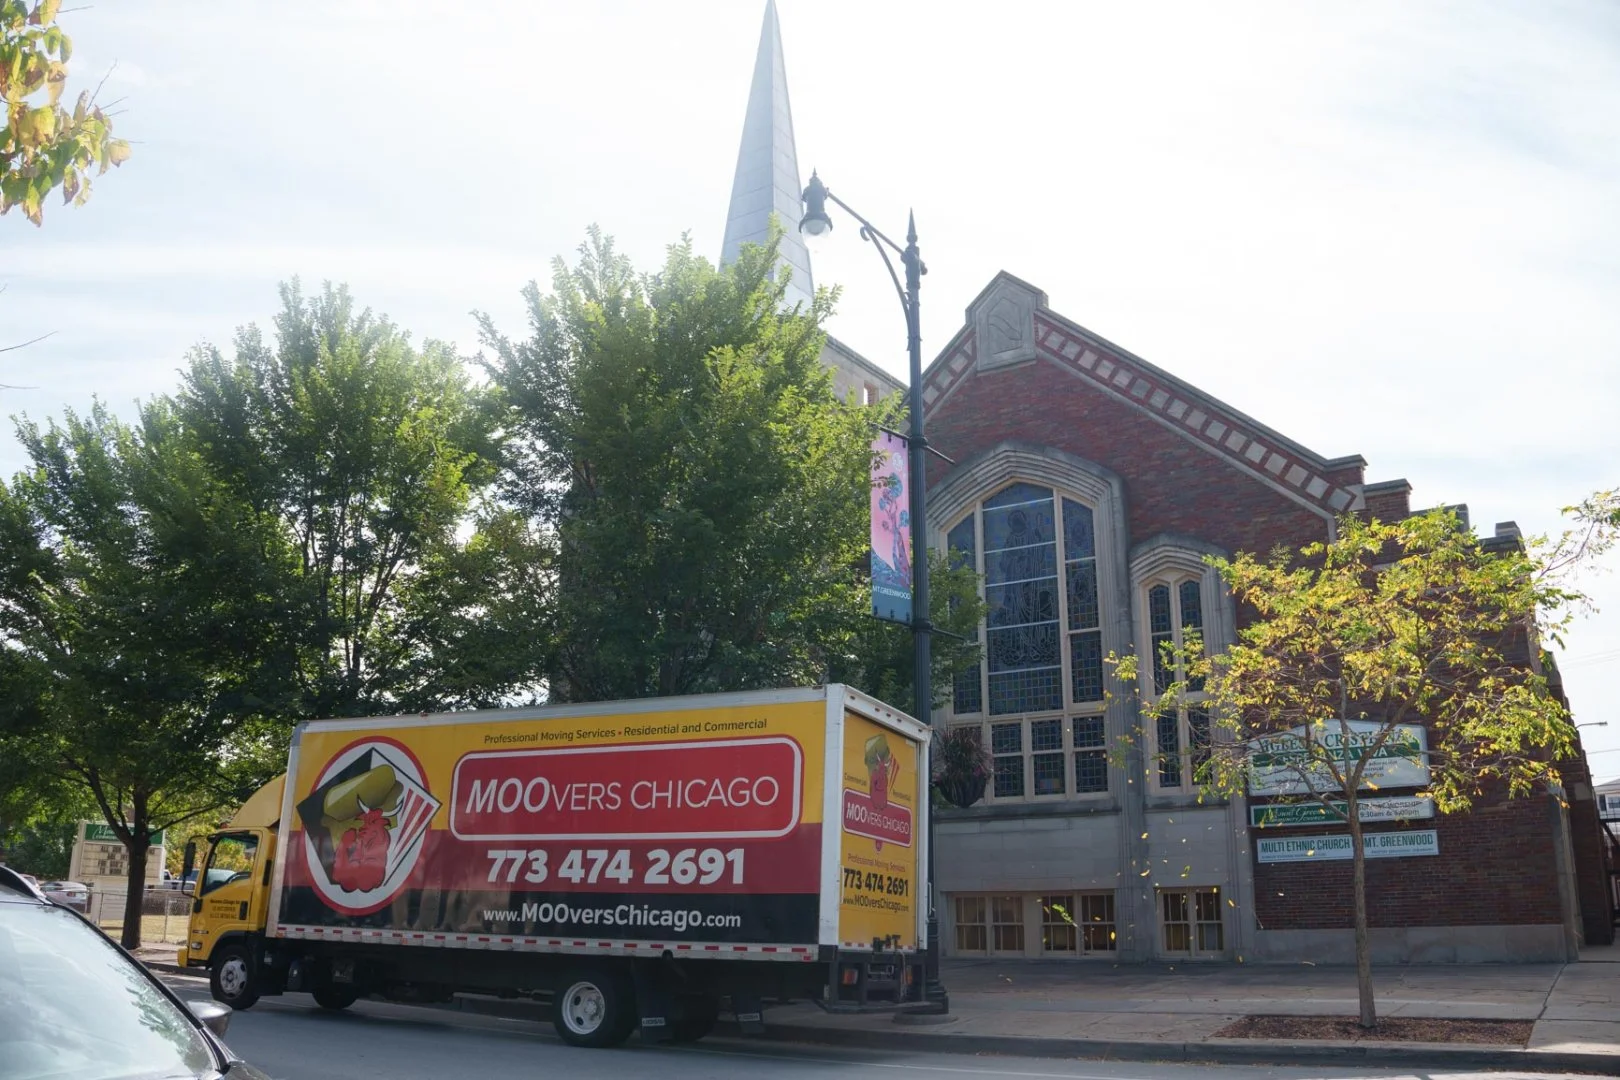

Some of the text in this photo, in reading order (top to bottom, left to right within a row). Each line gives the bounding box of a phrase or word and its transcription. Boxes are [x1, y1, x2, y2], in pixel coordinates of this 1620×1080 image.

[484, 718, 767, 743] Professional Moving Services Residential and Commercial
[630, 776, 780, 810] CHICAGO
[882, 815, 910, 835] CHICAGO
[1261, 833, 1434, 853] MULTI ETHNIC CHURCH MT. GREENWOOD
[487, 848, 745, 885] 773 474 2691
[483, 902, 741, 932] www.MOOversChicago.com
